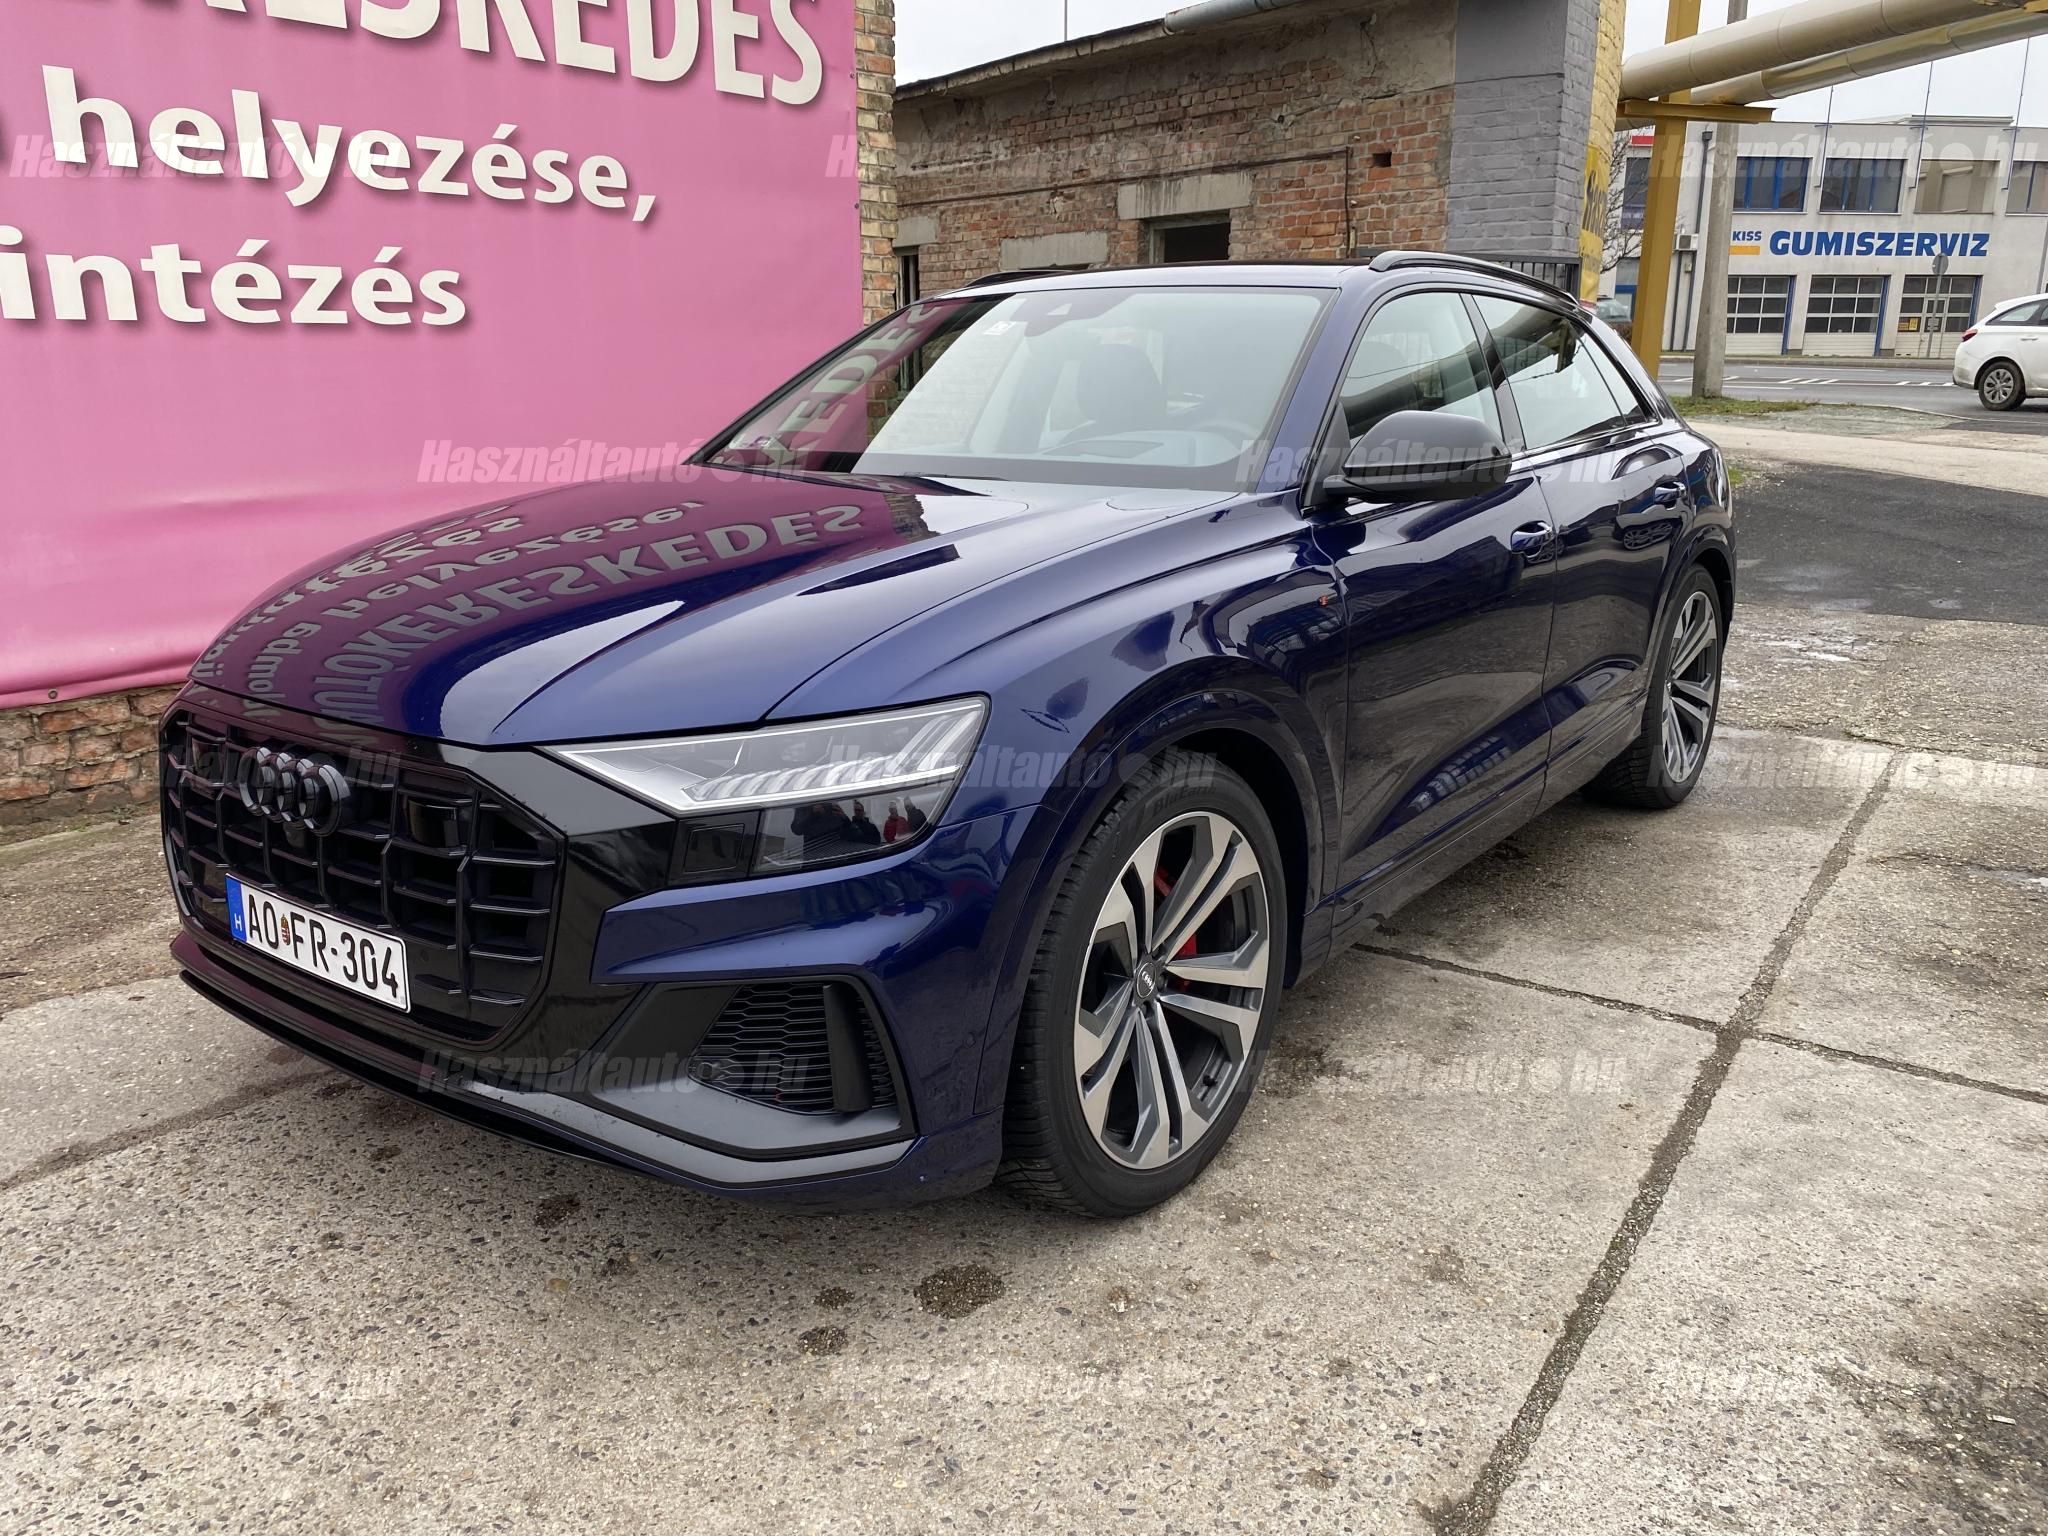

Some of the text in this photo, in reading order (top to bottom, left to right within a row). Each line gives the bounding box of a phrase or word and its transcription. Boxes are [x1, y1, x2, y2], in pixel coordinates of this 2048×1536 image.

[42, 64, 658, 223] helyezése,
[0, 225, 467, 326] intézés
[1732, 230, 1991, 257] KISS GUMISZERVIZ
[234, 913, 243, 932] H
[290, 911, 399, 998] FR-304
